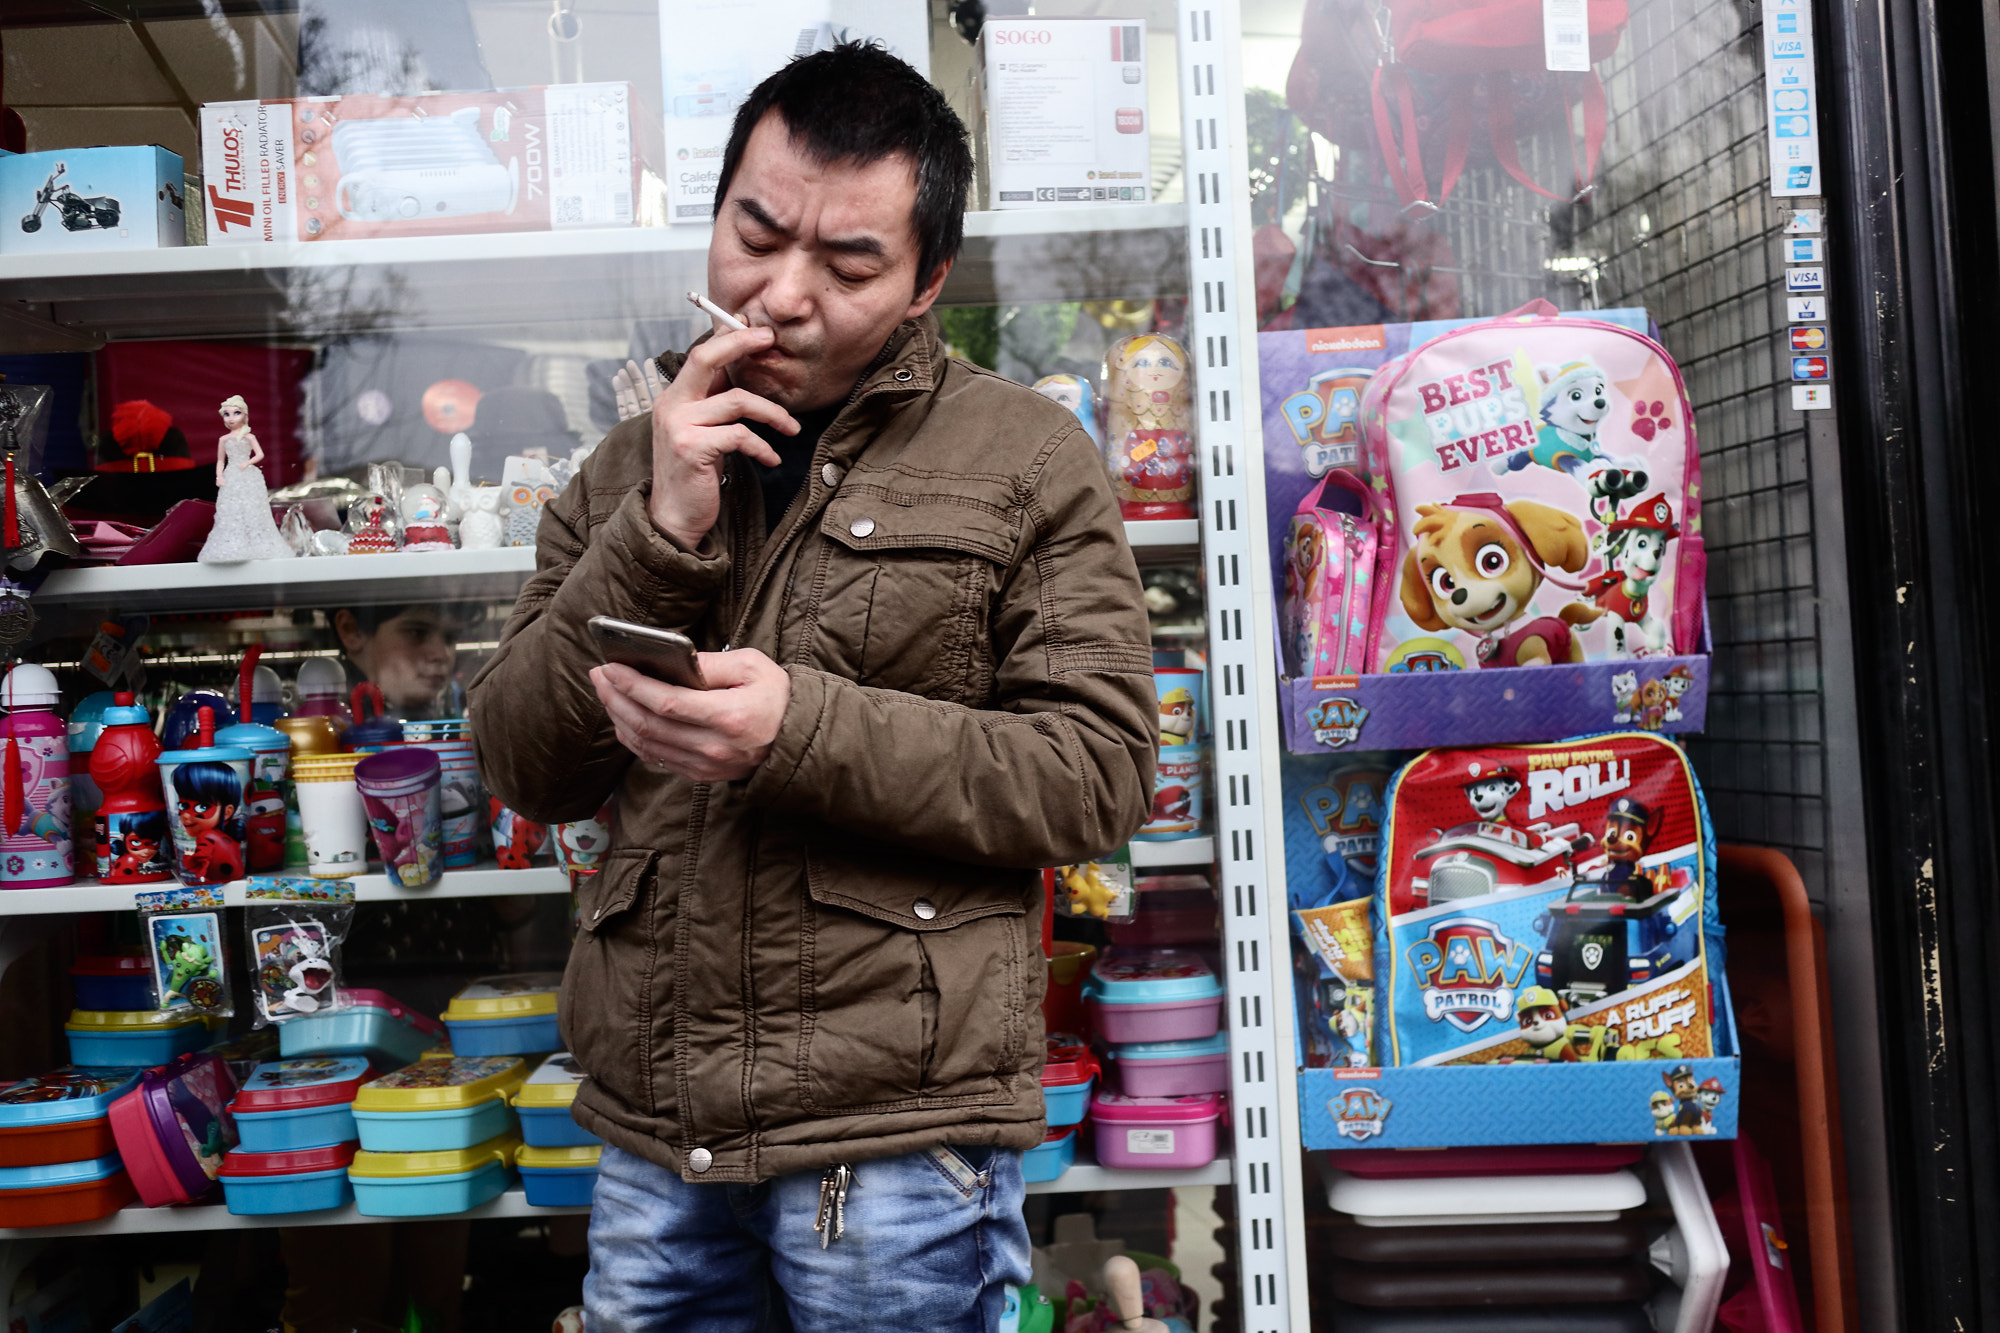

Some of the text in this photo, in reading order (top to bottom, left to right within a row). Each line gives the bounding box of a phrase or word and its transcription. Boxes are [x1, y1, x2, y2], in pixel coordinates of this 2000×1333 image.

[995, 30, 1051, 45] SOGO
[1777, 41, 1802, 52] VISA
[223, 127, 242, 193] THULOS
[257, 105, 273, 242] MINI OIL FILLED RADIATOR
[275, 139, 286, 203] ENERGY SAVER
[525, 124, 543, 201] 700W
[1792, 272, 1818, 282] VISA
[1312, 337, 1381, 351] nickelodeon
[1418, 359, 1513, 415] BEST
[1425, 388, 1529, 446] PUPS
[1436, 420, 1536, 472] EVER!
[1305, 705, 1370, 731] PAW
[1319, 729, 1353, 739] PATROL
[1527, 749, 1617, 772] PAW PATROL
[1527, 758, 1631, 820] ROLL!
[1405, 934, 1533, 990] PAW
[1434, 992, 1502, 1009] PATROL
[1605, 989, 1692, 1028] A RUFF-
[1626, 999, 1697, 1042] RUFF
[1326, 1096, 1393, 1122] PAW
